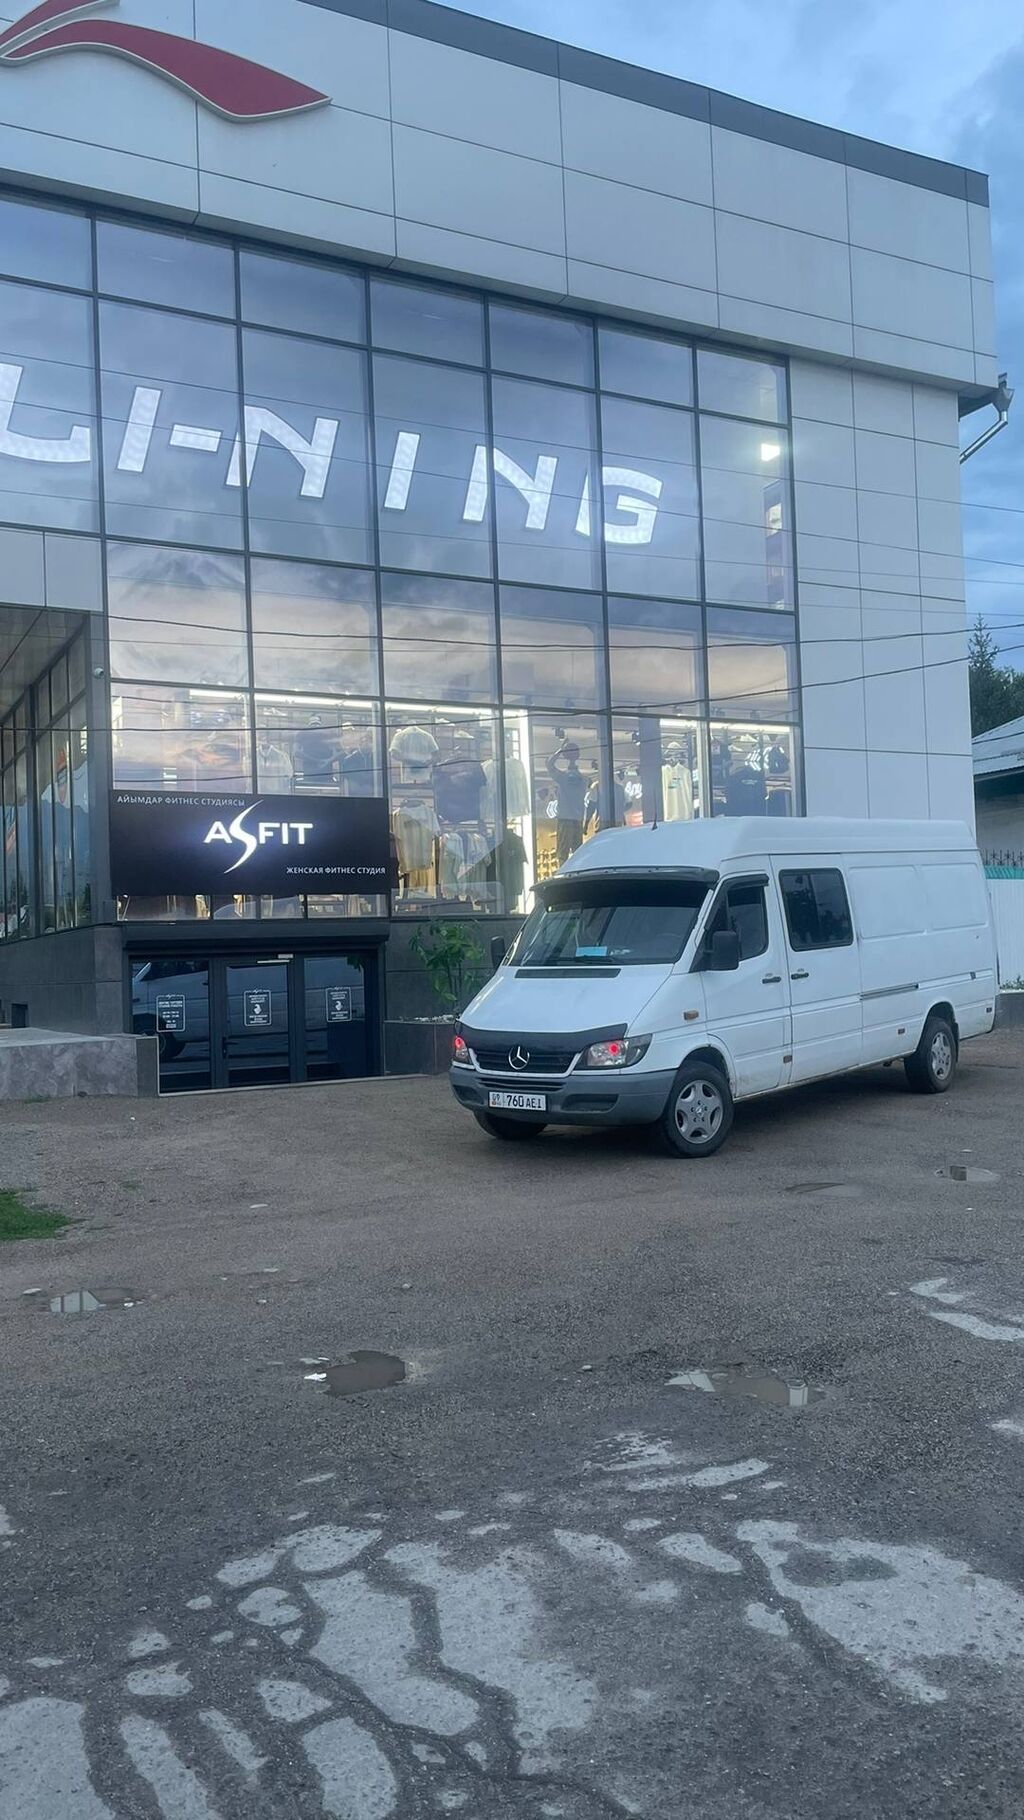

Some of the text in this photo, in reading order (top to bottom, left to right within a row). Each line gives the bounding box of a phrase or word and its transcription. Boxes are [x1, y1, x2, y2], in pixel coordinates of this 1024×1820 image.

[0, 363, 663, 544] LI-NING
[117, 794, 245, 806] АЙЫМДАР ФИТНЕС СТУДИЯСЫ
[286, 866, 386, 875] ЖЕНСКАЯ ФИТНЕС СТУДИЯ
